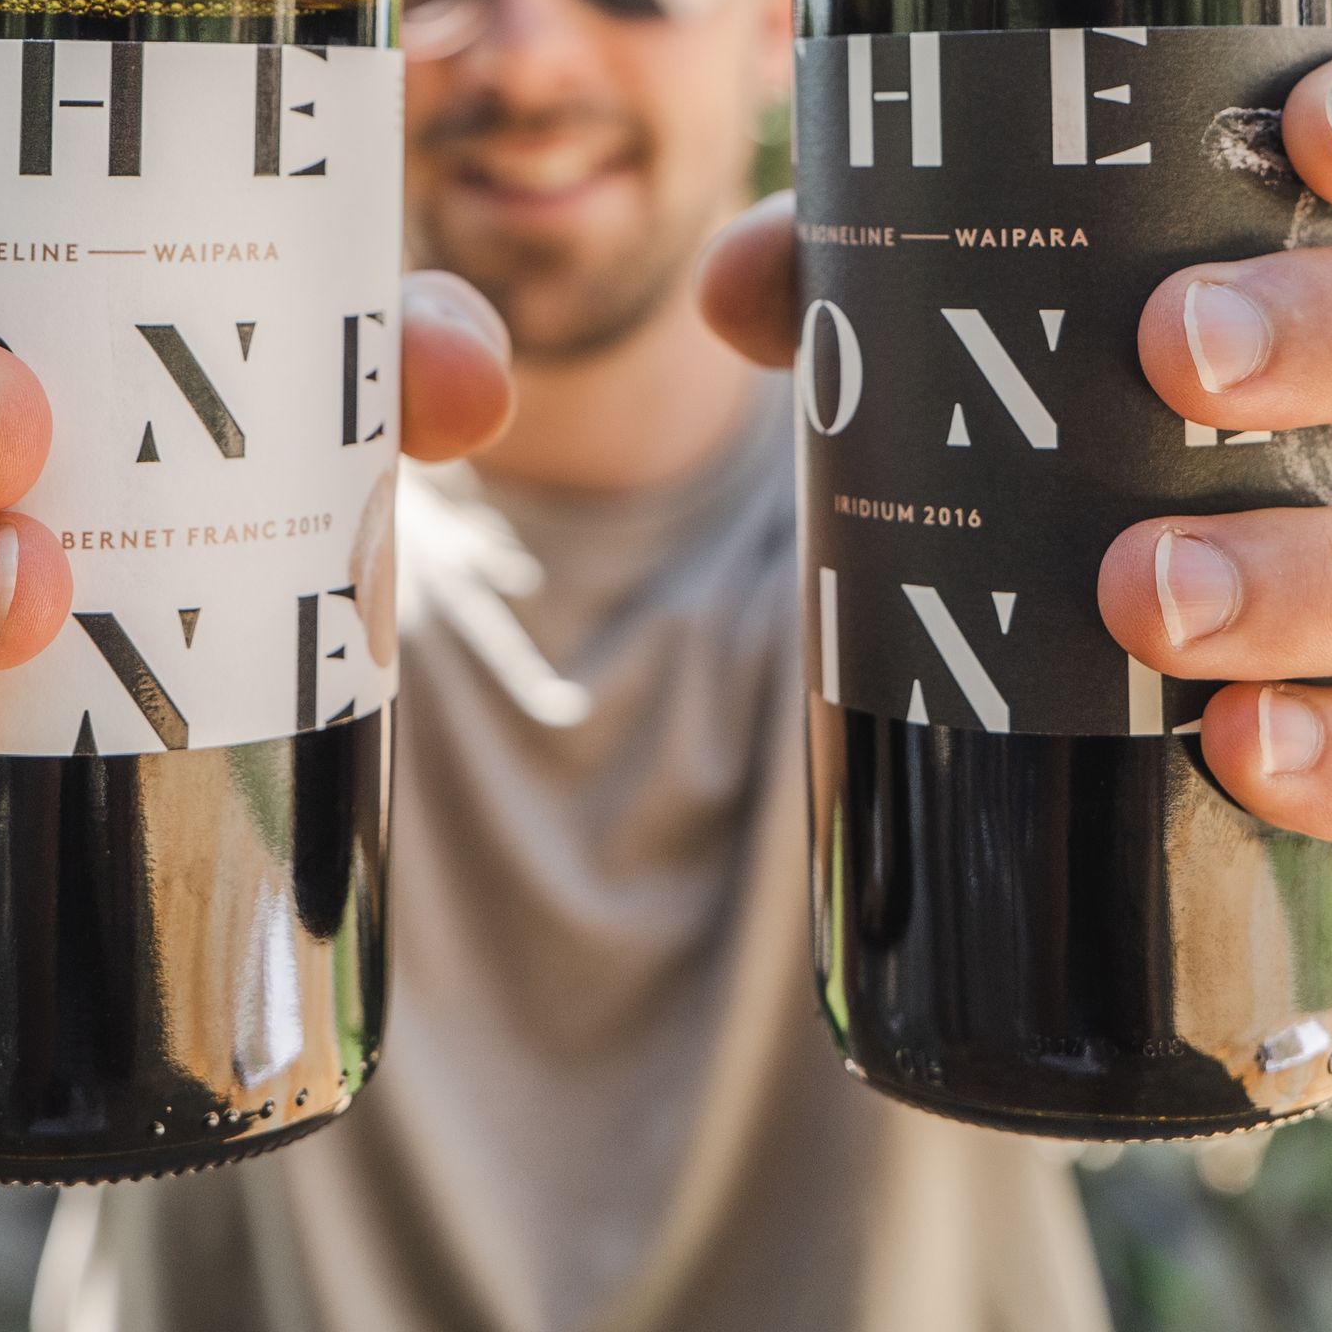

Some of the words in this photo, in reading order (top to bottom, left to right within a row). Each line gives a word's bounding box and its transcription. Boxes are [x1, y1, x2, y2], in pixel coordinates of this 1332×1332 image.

[798, 28, 1152, 167] HE
[153, 242, 279, 261] WAIPARA
[955, 227, 1089, 248] WAIPARA
[801, 299, 1273, 450] ON
[834, 494, 914, 523] IRIDIUM
[923, 506, 982, 528] 2016
[61, 529, 175, 550] BERNET
[187, 521, 277, 546] FRANC
[286, 513, 333, 536] 2019
